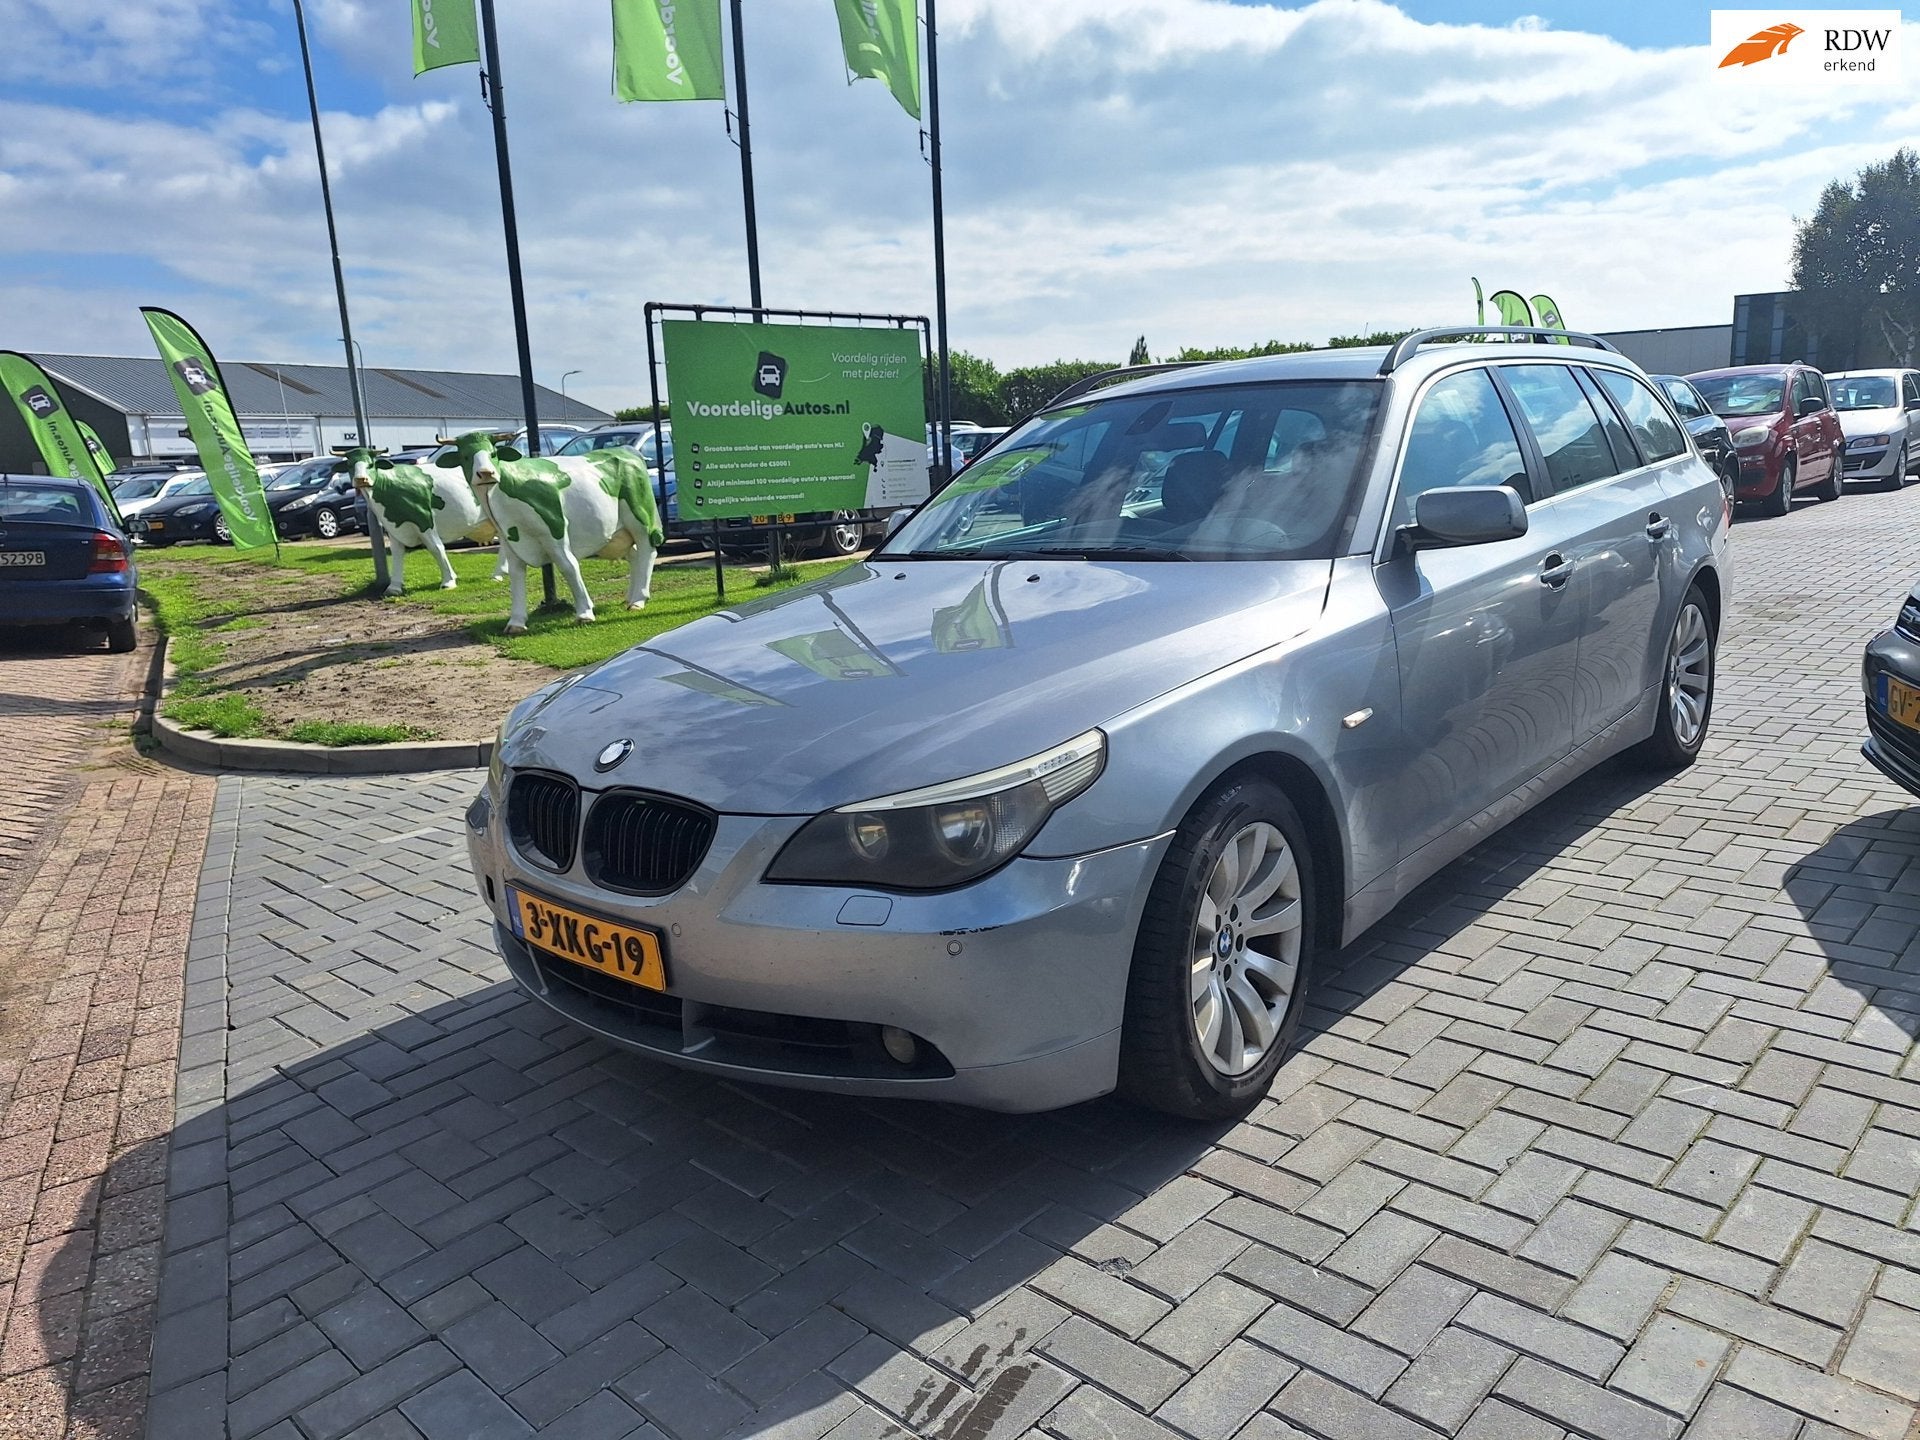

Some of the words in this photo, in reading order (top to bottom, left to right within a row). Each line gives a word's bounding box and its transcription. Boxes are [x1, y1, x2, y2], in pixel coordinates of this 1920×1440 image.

[832, 352, 877, 365] Voordelig
[880, 354, 907, 366] rijden
[842, 369, 862, 378] met
[864, 368, 899, 380] plezier!
[686, 400, 850, 420] VoordeligeAutos.nl
[707, 479, 725, 488] Altijd
[725, 478, 756, 486] minimaal
[525, 901, 645, 977] 3-XKG-19
